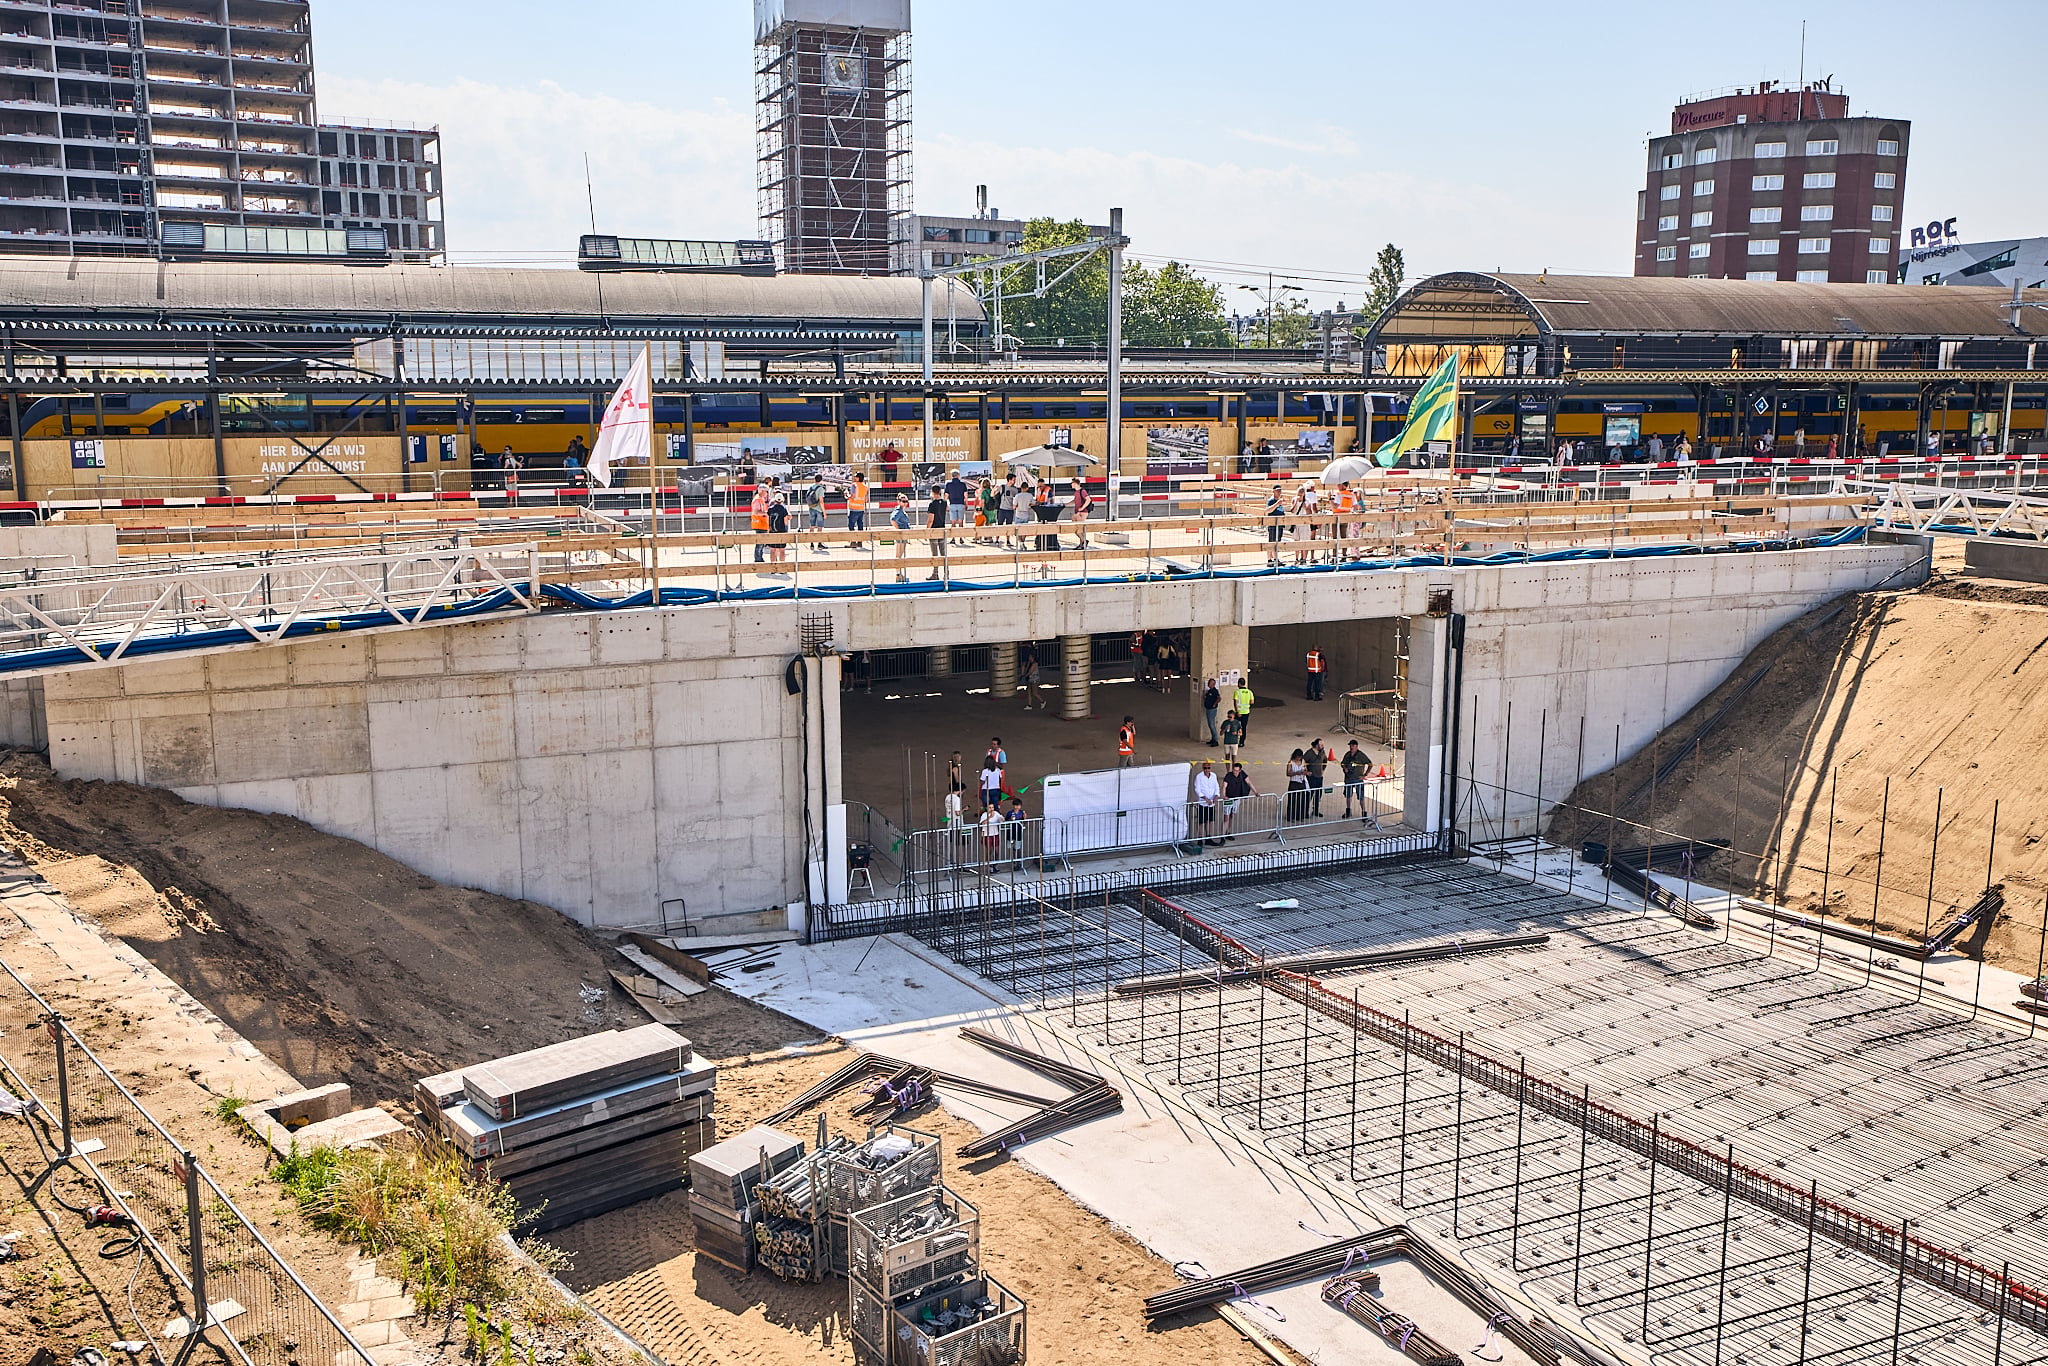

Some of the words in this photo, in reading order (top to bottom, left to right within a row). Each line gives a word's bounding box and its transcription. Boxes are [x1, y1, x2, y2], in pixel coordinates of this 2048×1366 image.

[1677, 111, 1725, 127] Mercure
[1911, 216, 1957, 247] ROC
[1911, 245, 1959, 262] Nijmegen
[515, 413, 523, 423] 2
[950, 409, 956, 419] 2
[853, 438, 870, 448] WIJ
[908, 437, 924, 447] HET
[932, 437, 960, 447] TATION
[260, 445, 286, 456] HIER
[344, 444, 365, 456] WIJ
[853, 452, 880, 462] KLAA
[912, 452, 924, 461] DE
[261, 461, 285, 473] AAN
